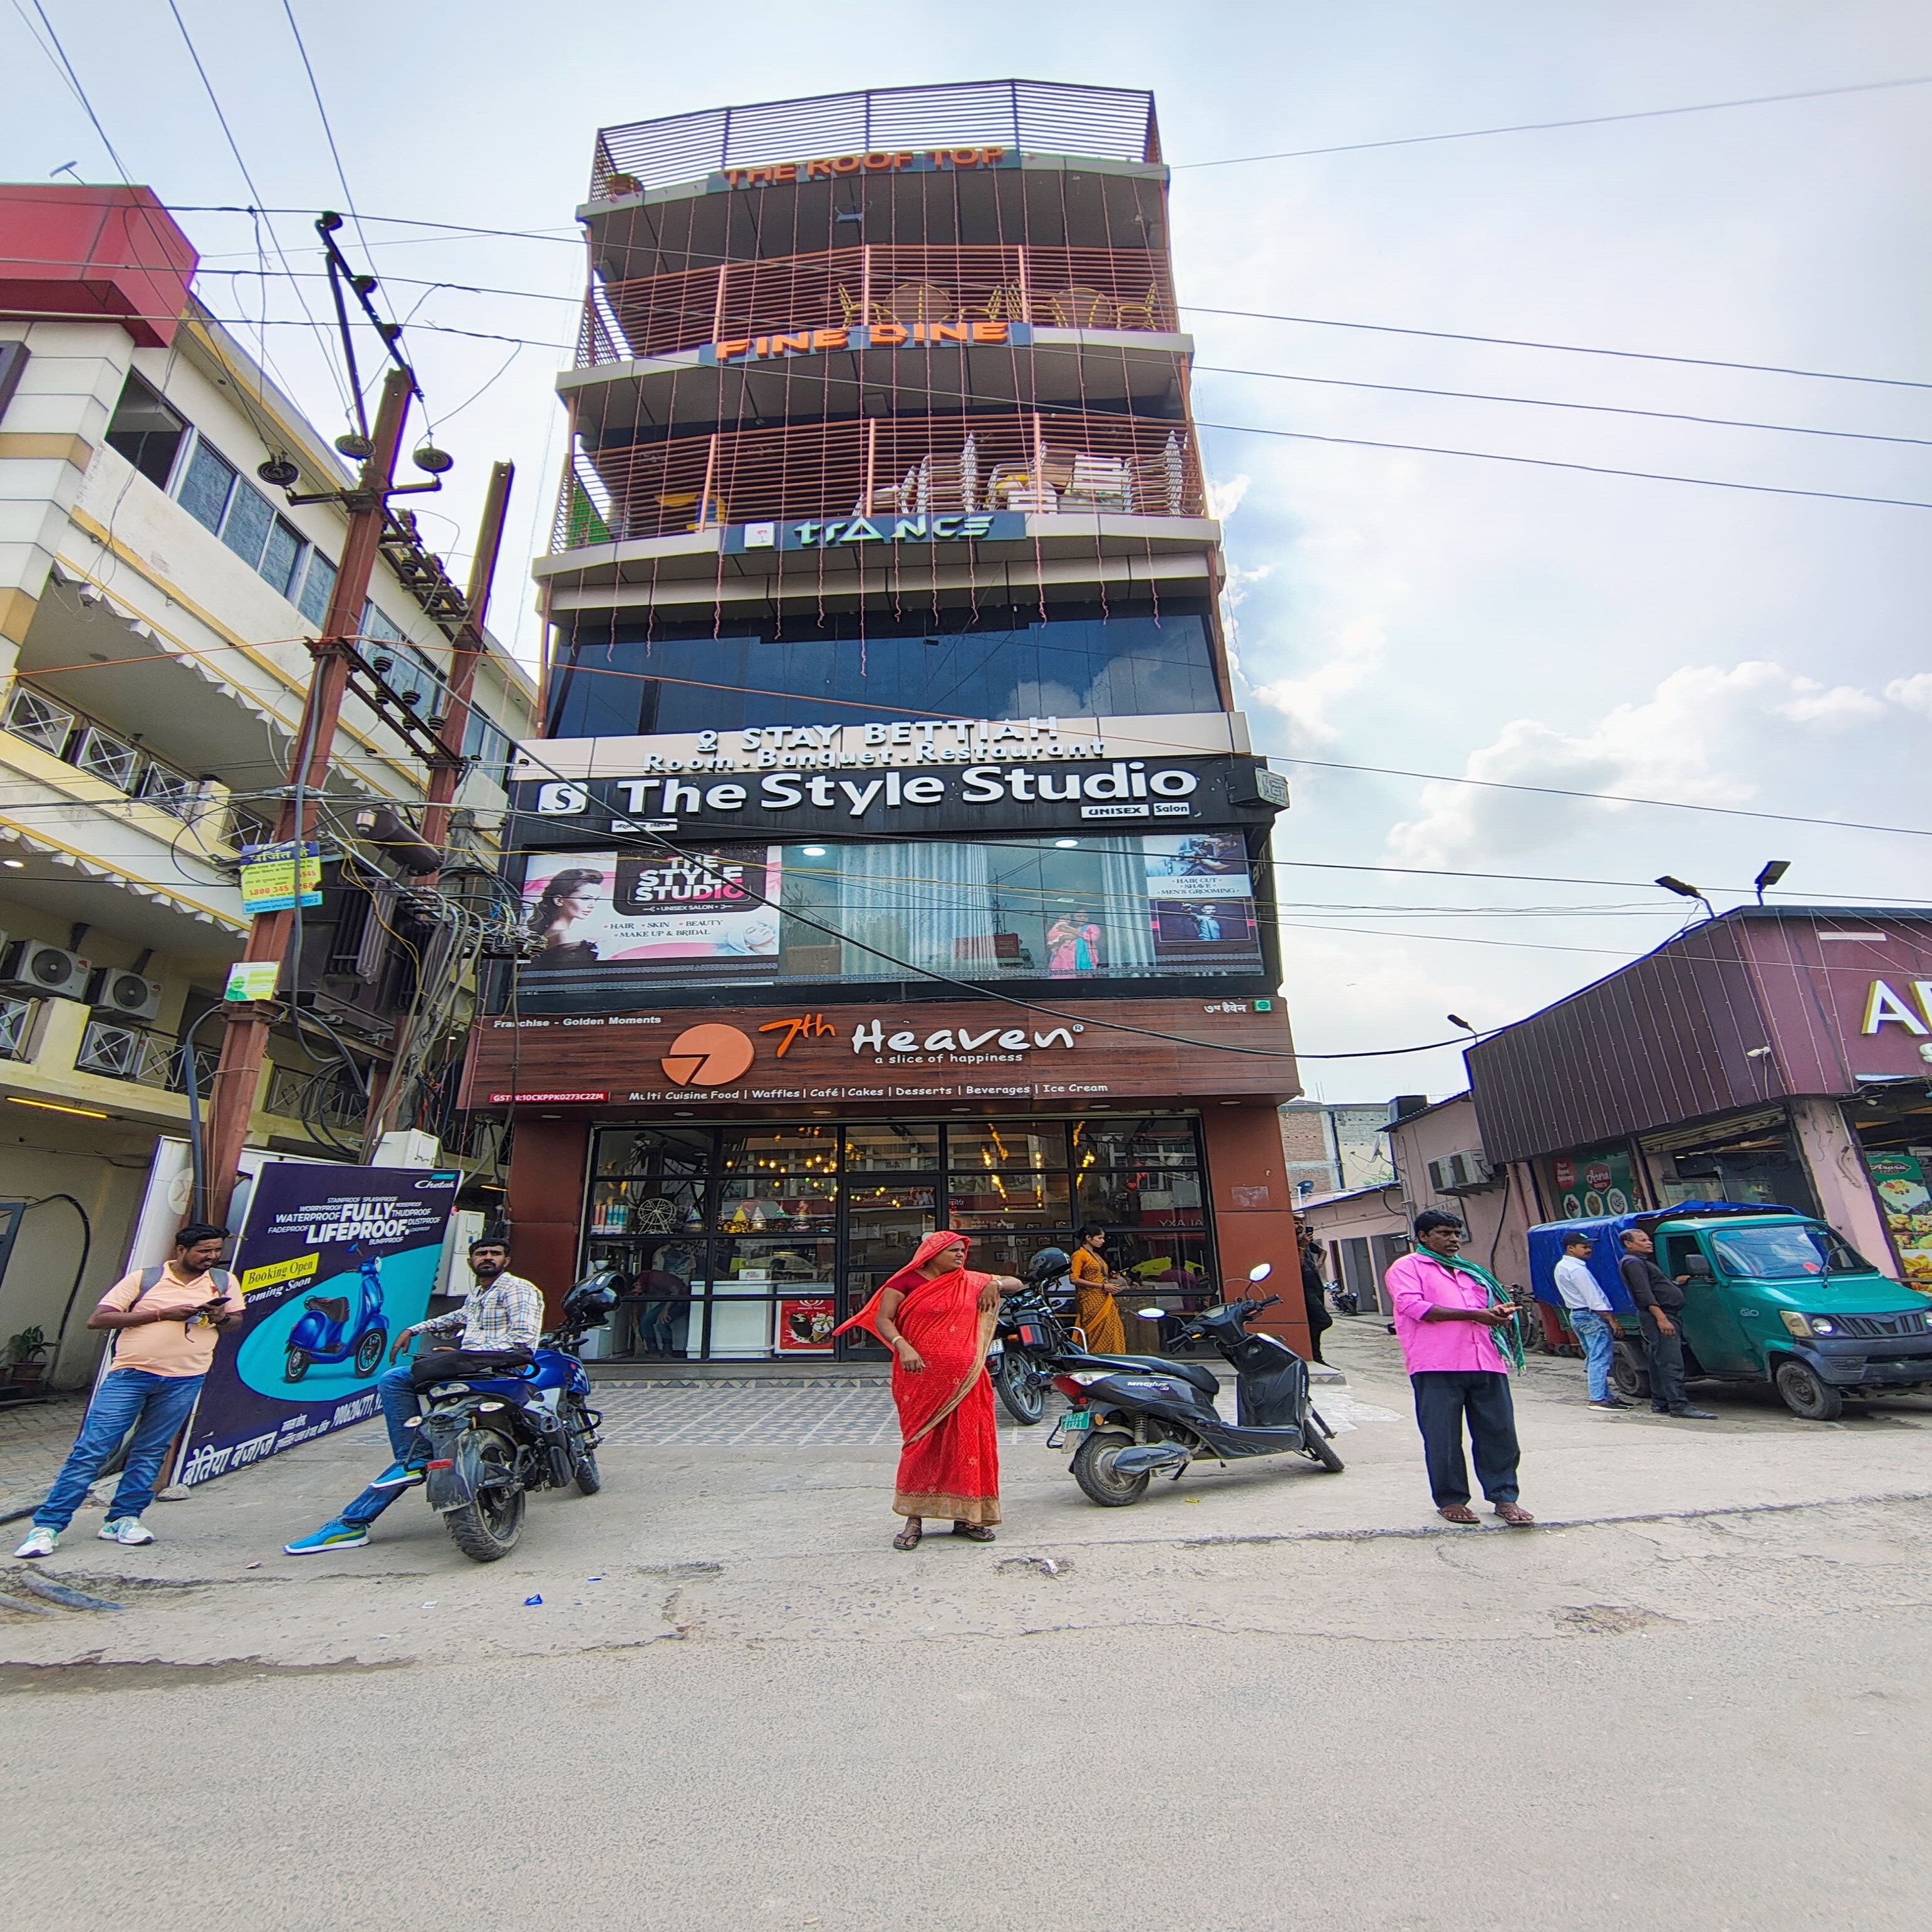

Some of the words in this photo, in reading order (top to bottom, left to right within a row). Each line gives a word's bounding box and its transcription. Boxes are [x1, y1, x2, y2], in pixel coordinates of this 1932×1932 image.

[724, 164, 796, 187] THE
[806, 152, 913, 176] ROOF
[931, 147, 1004, 165] TOP
[716, 328, 850, 361] FINE
[870, 322, 1008, 346] DINE
[740, 724, 841, 750] STAY
[865, 716, 1059, 745] BETTIAH
[643, 752, 734, 772] Room
[758, 745, 891, 769] Banquet
[915, 738, 1103, 762] Restaurant
[617, 778, 746, 814] The
[761, 771, 944, 818] Style
[962, 761, 1198, 804] Studio
[1088, 806, 1143, 815] UNISEX
[1155, 802, 1188, 813] Salon
[667, 855, 719, 869] THE
[638, 866, 744, 887] STYLE
[635, 884, 745, 901] STUDIO
[563, 1017, 605, 1027] Golden
[608, 1015, 661, 1025] Moments
[758, 1014, 836, 1059] 7th
[851, 1019, 1073, 1054] Heaven
[889, 1053, 924, 1064] slice
[928, 1053, 944, 1063] of
[950, 1052, 1023, 1064] happiness
[665, 1091, 708, 1099] Cuisine
[711, 1090, 739, 1099] Food
[752, 1089, 800, 1099] Waffles
[810, 1087, 838, 1097] Café
[848, 1087, 883, 1096] Cakes
[896, 1086, 952, 1096] Desserts
[966, 1084, 1031, 1096] Beverages
[1043, 1083, 1066, 1093] Ice
[1069, 1083, 1108, 1093] Cream
[414, 1180, 455, 1189] Chetak
[276, 1212, 341, 1223] WATERPROOF
[392, 1208, 432, 1218] THUDPROOF
[299, 1204, 342, 1212] WORRYPROOF
[340, 1202, 395, 1222] FULLY
[267, 1225, 309, 1234] FADEPROOF
[306, 1219, 410, 1244] LIFEPROOF.
[407, 1217, 442, 1226] DUSTPROOF
[247, 1267, 288, 1285] Booking
[290, 1261, 313, 1275] Open
[243, 1285, 284, 1303] Coming
[285, 1277, 311, 1292] Soon
[182, 1444, 234, 1485] बेतिया
[232, 1431, 277, 1467] बजाज
